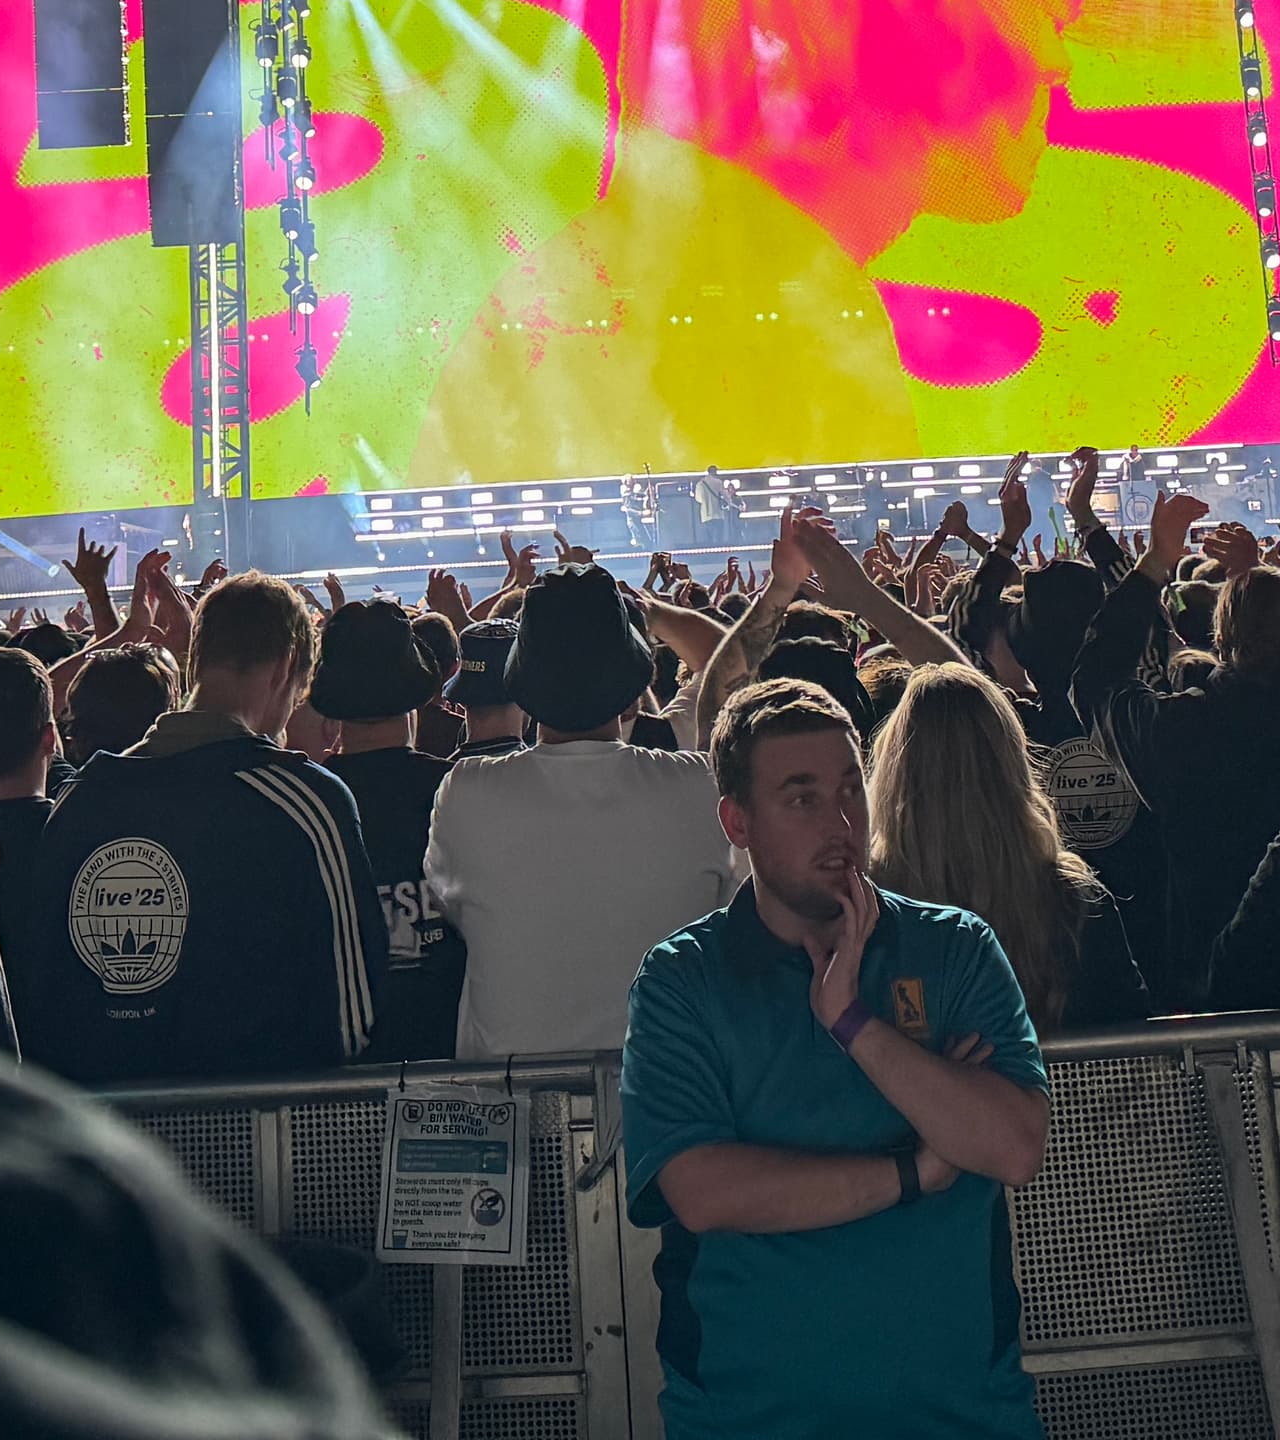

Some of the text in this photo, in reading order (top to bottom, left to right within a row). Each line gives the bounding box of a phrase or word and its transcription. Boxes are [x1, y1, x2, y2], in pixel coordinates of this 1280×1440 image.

[1057, 775, 1088, 789] live
[76, 846, 184, 911] THE BAND WITH THE 3 STRIPES
[428, 1103, 488, 1117] DO NOT USE
[430, 1113, 482, 1126] BIN WATER
[420, 1124, 488, 1136] FOR SERVING!
[404, 1199, 420, 1207] NOT
[412, 1230, 432, 1238] Thank
